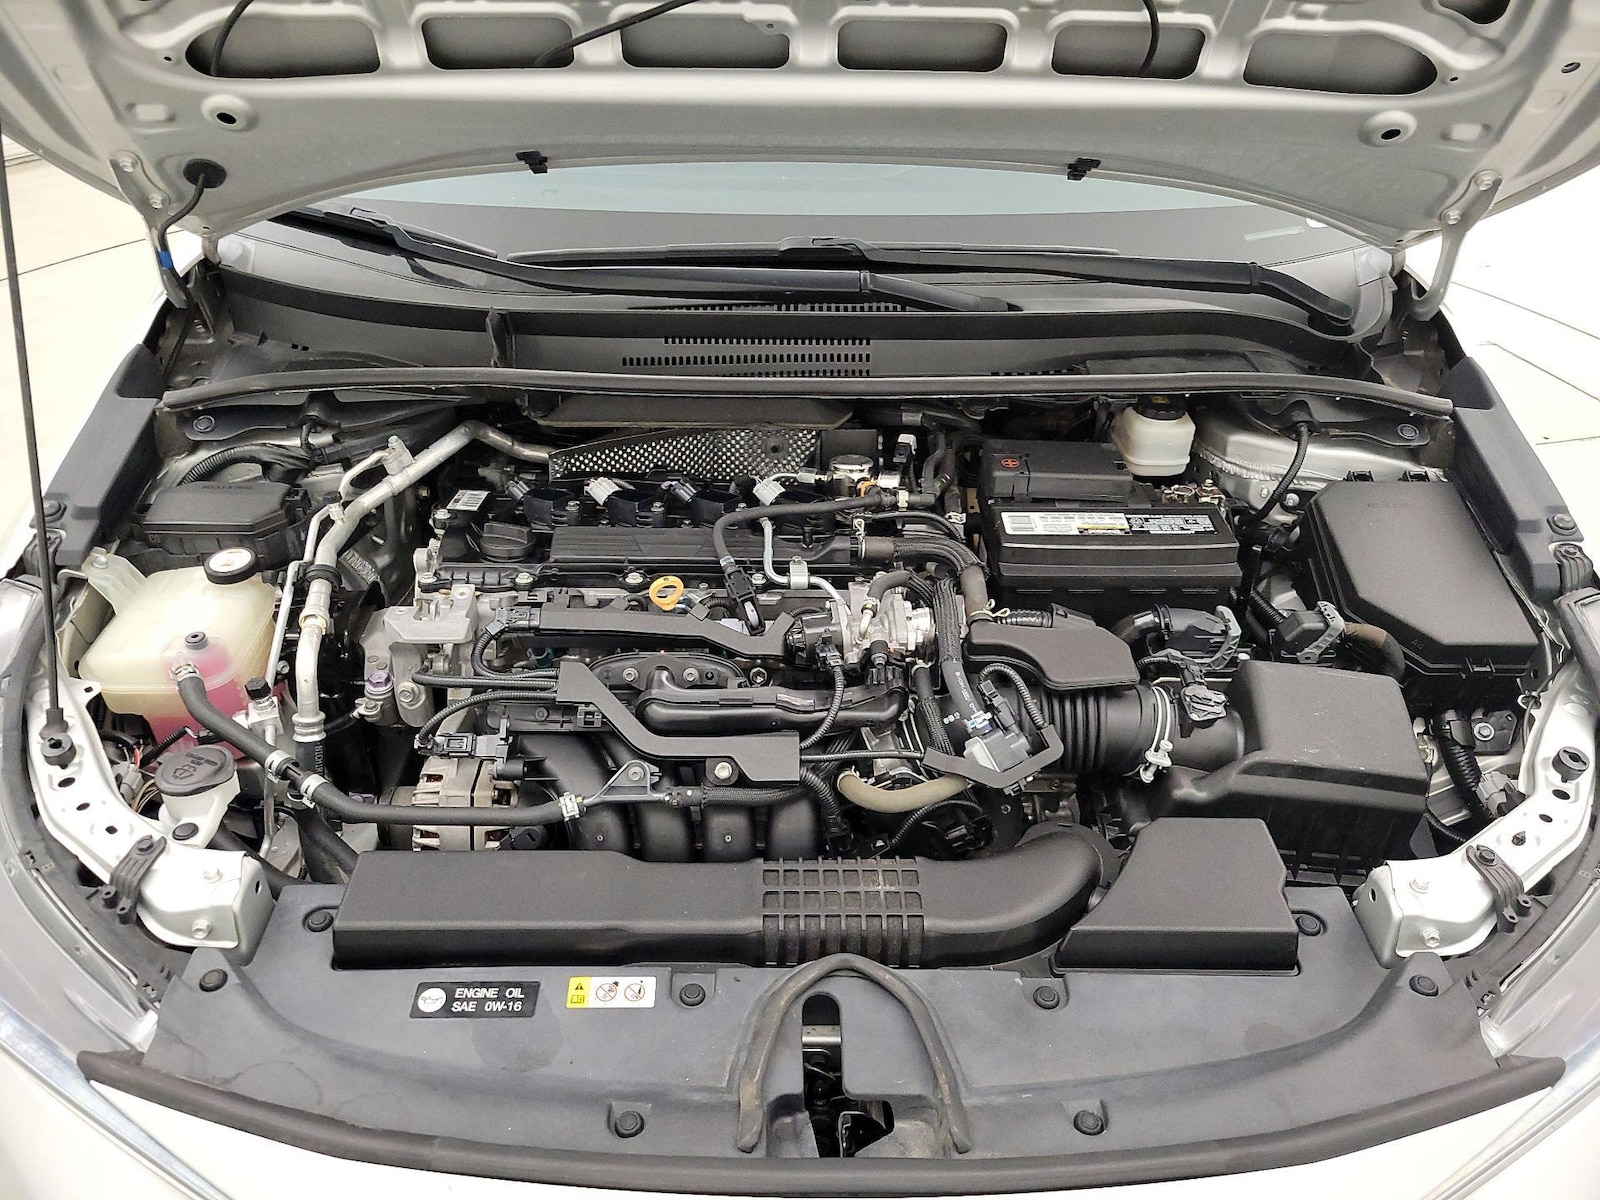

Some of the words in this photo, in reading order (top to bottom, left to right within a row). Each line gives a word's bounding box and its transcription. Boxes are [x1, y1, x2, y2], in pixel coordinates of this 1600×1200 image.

[455, 987, 499, 998] ENGINE
[505, 987, 525, 998] OIL
[451, 1001, 477, 1012] SAE
[484, 1001, 522, 1012] 0W-16
